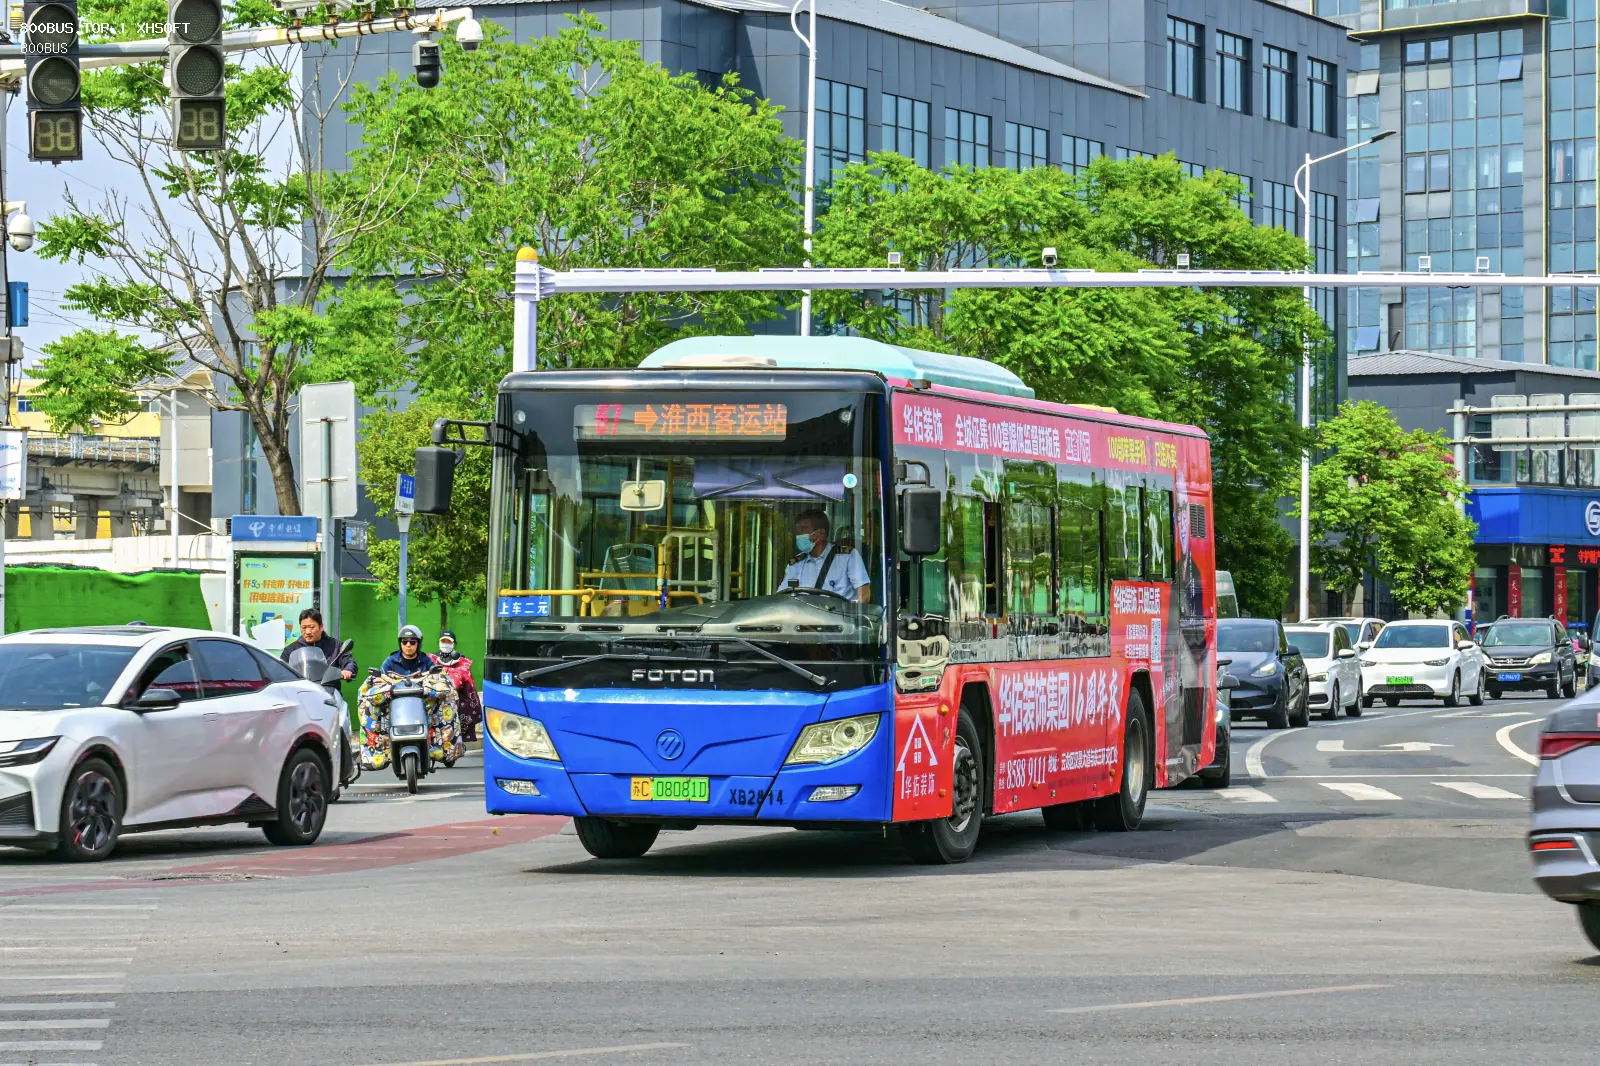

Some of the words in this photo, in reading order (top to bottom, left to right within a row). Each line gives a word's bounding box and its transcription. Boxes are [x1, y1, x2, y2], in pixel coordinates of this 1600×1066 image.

[661, 404, 787, 435] 淮西客运站
[903, 404, 943, 445] 华佑装饰
[499, 601, 548, 615] 上车二元
[631, 669, 715, 683] FOTON
[905, 772, 936, 799] 华佑装饰
[1007, 759, 1026, 789] 8588
[1027, 756, 1046, 787] 9111
